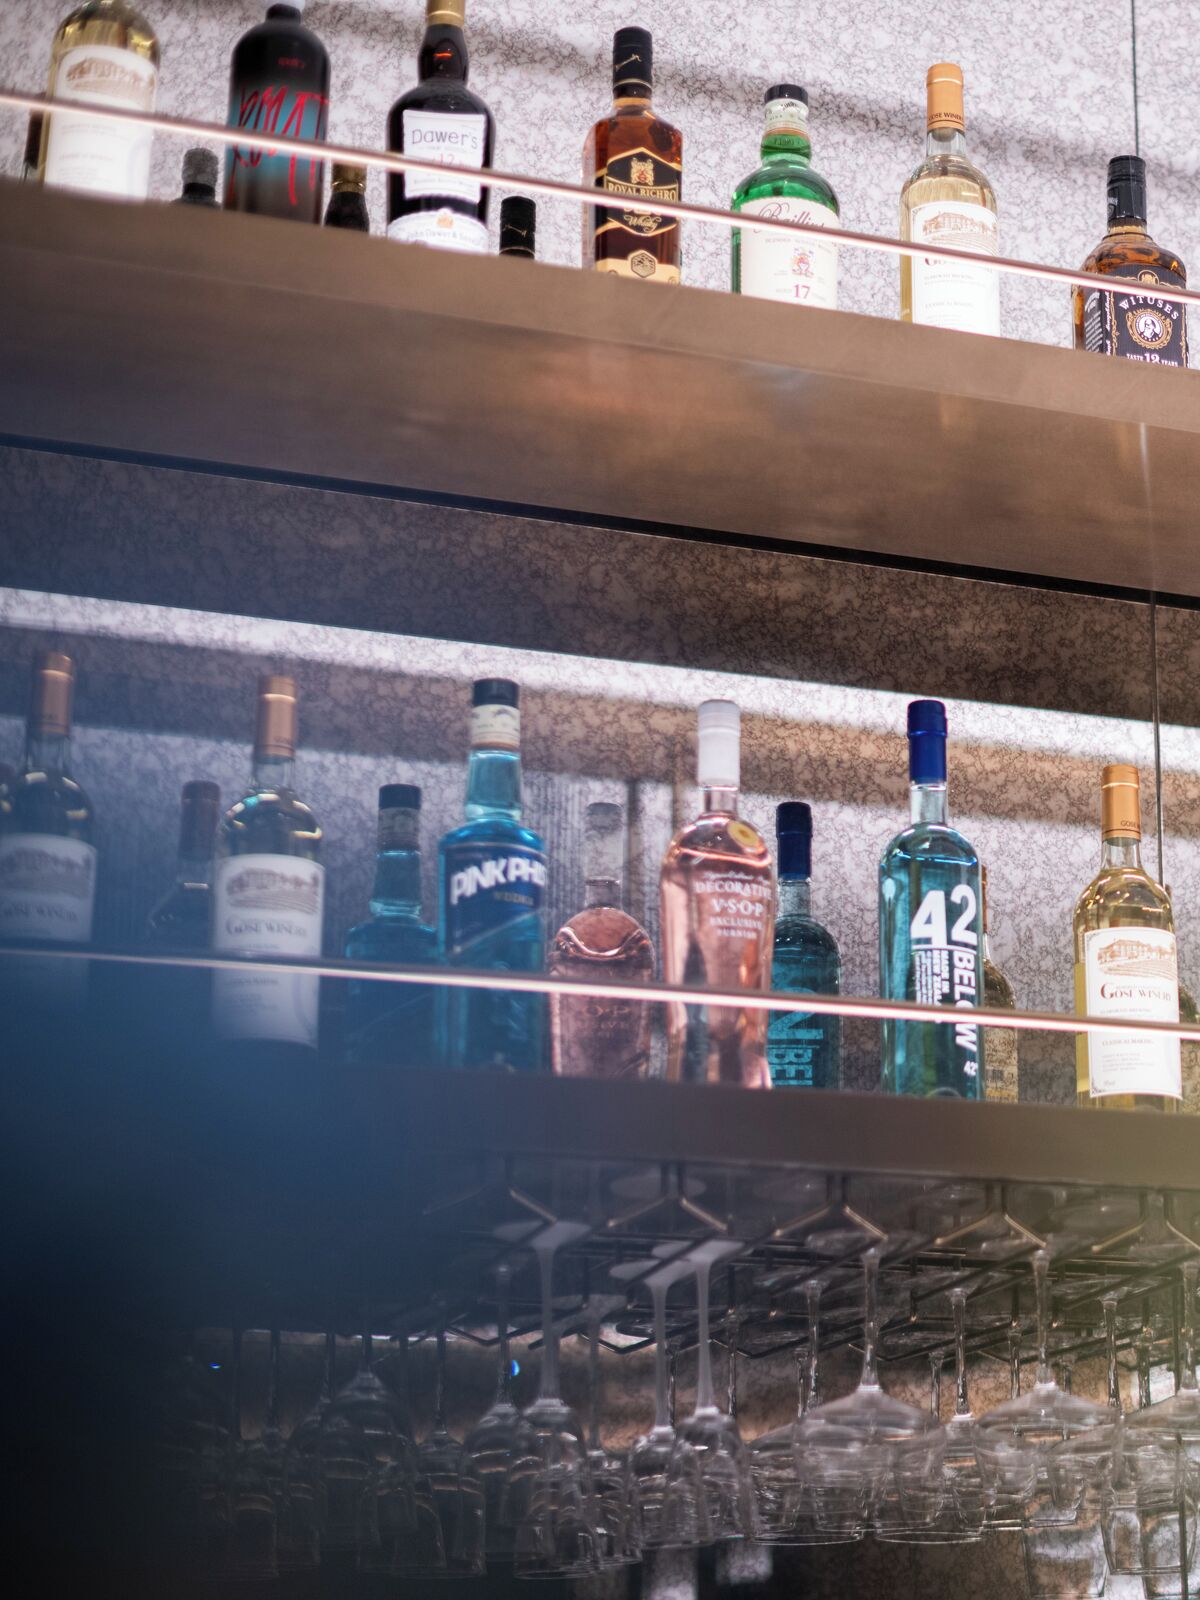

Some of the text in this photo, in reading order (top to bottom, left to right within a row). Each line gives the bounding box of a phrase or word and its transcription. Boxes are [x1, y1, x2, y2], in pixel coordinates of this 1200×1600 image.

[608, 182, 639, 197] ROYAL
[794, 284, 811, 300] 17
[1118, 295, 1180, 320] WITUSES
[450, 858, 508, 906] PINK
[694, 880, 772, 900] DECORATIVE
[910, 884, 978, 946] 42
[1101, 982, 1172, 1002] GOSE WINERY
